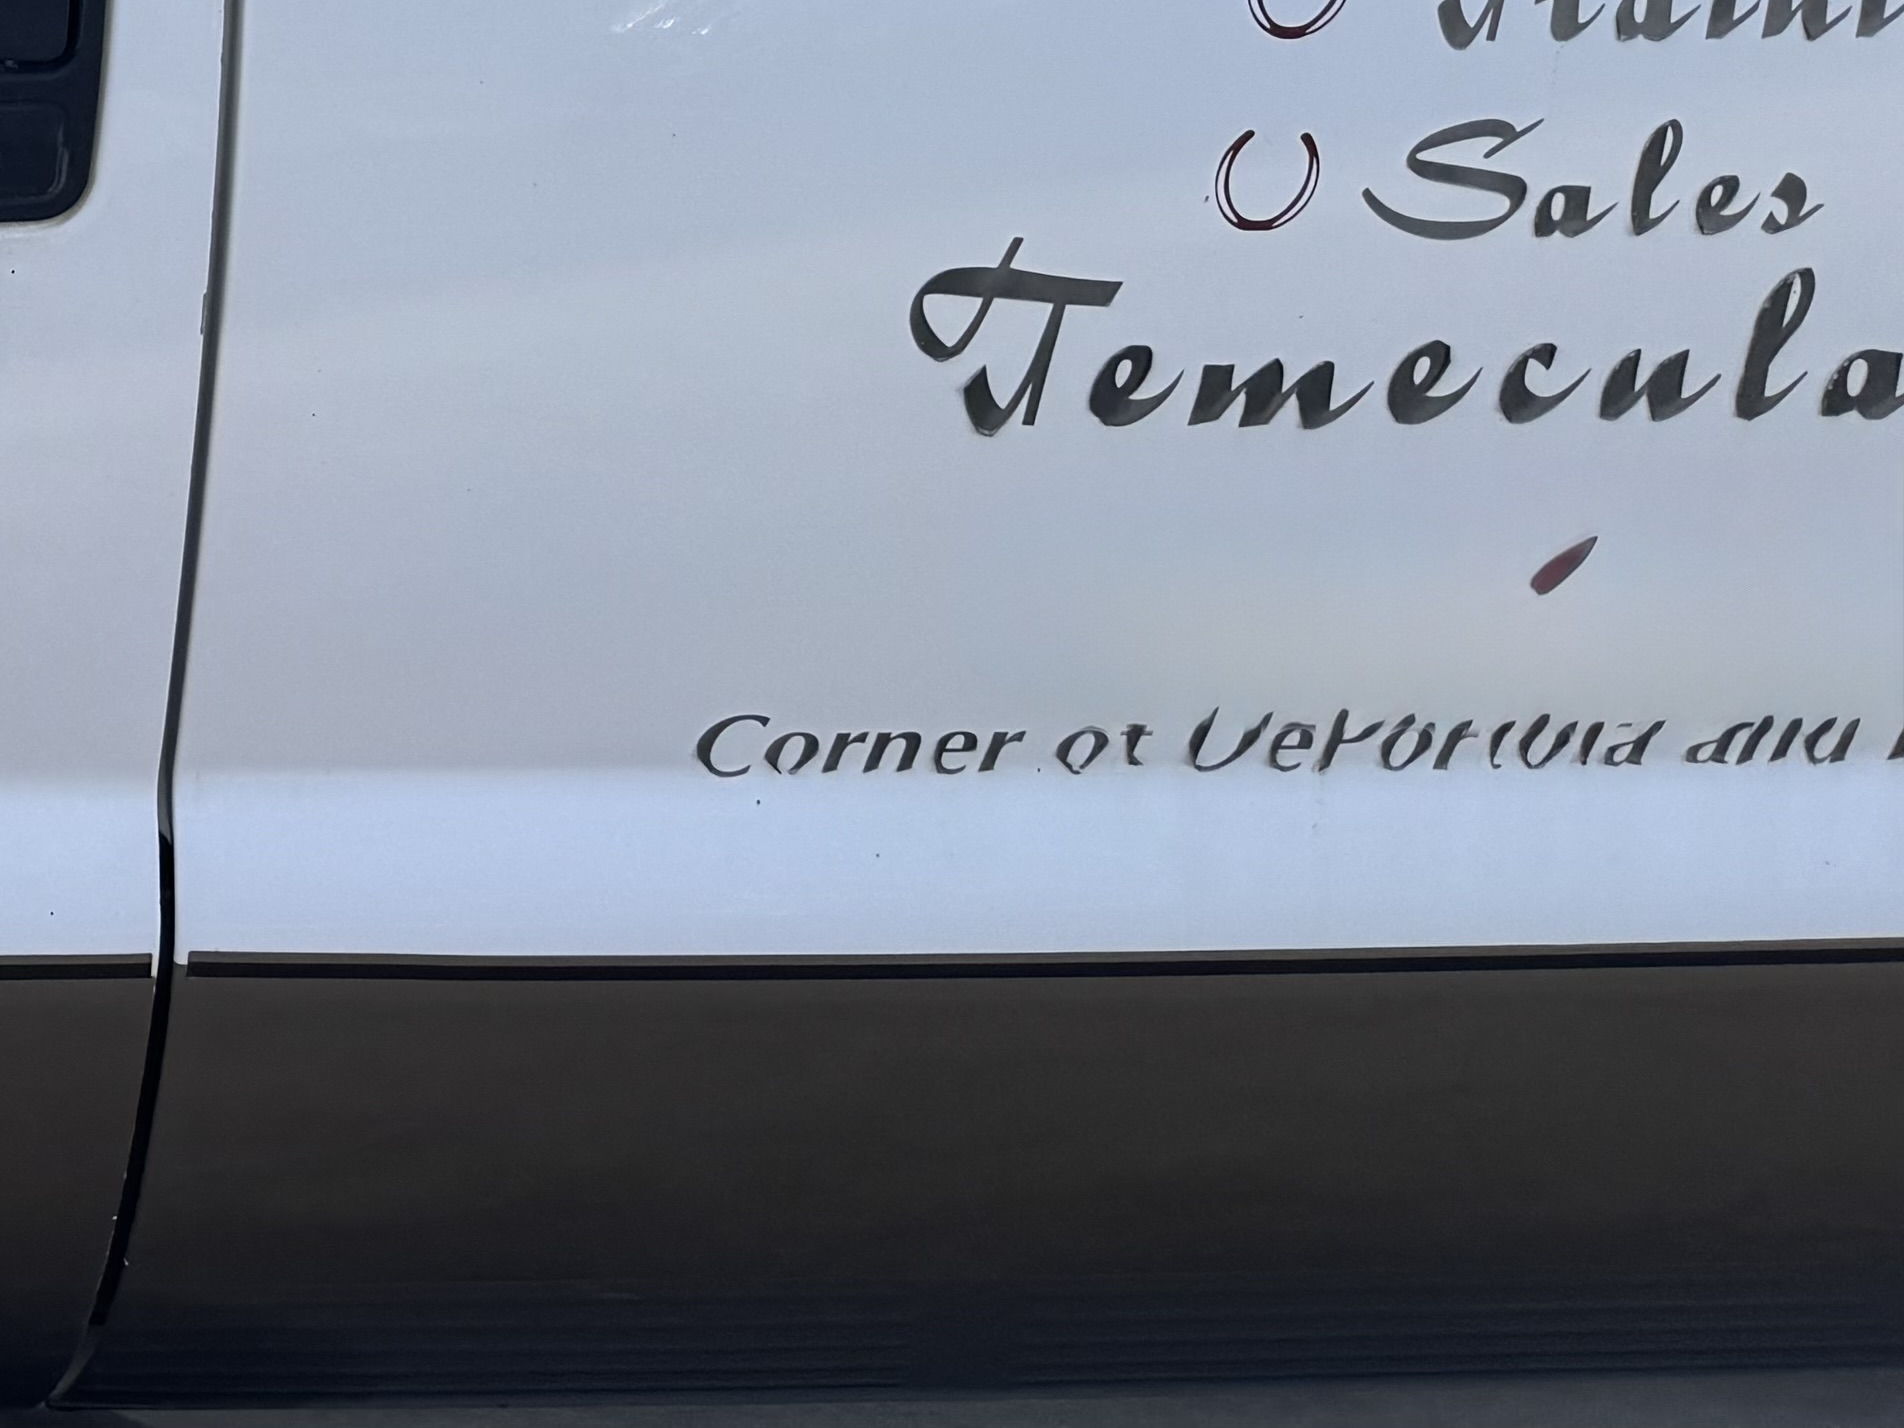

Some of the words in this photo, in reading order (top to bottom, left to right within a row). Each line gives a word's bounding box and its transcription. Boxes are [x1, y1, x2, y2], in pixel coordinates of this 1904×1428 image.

[1362, 117, 1825, 241] Sales
[908, 235, 1904, 437] Temecula
[695, 713, 1028, 778] Corner
